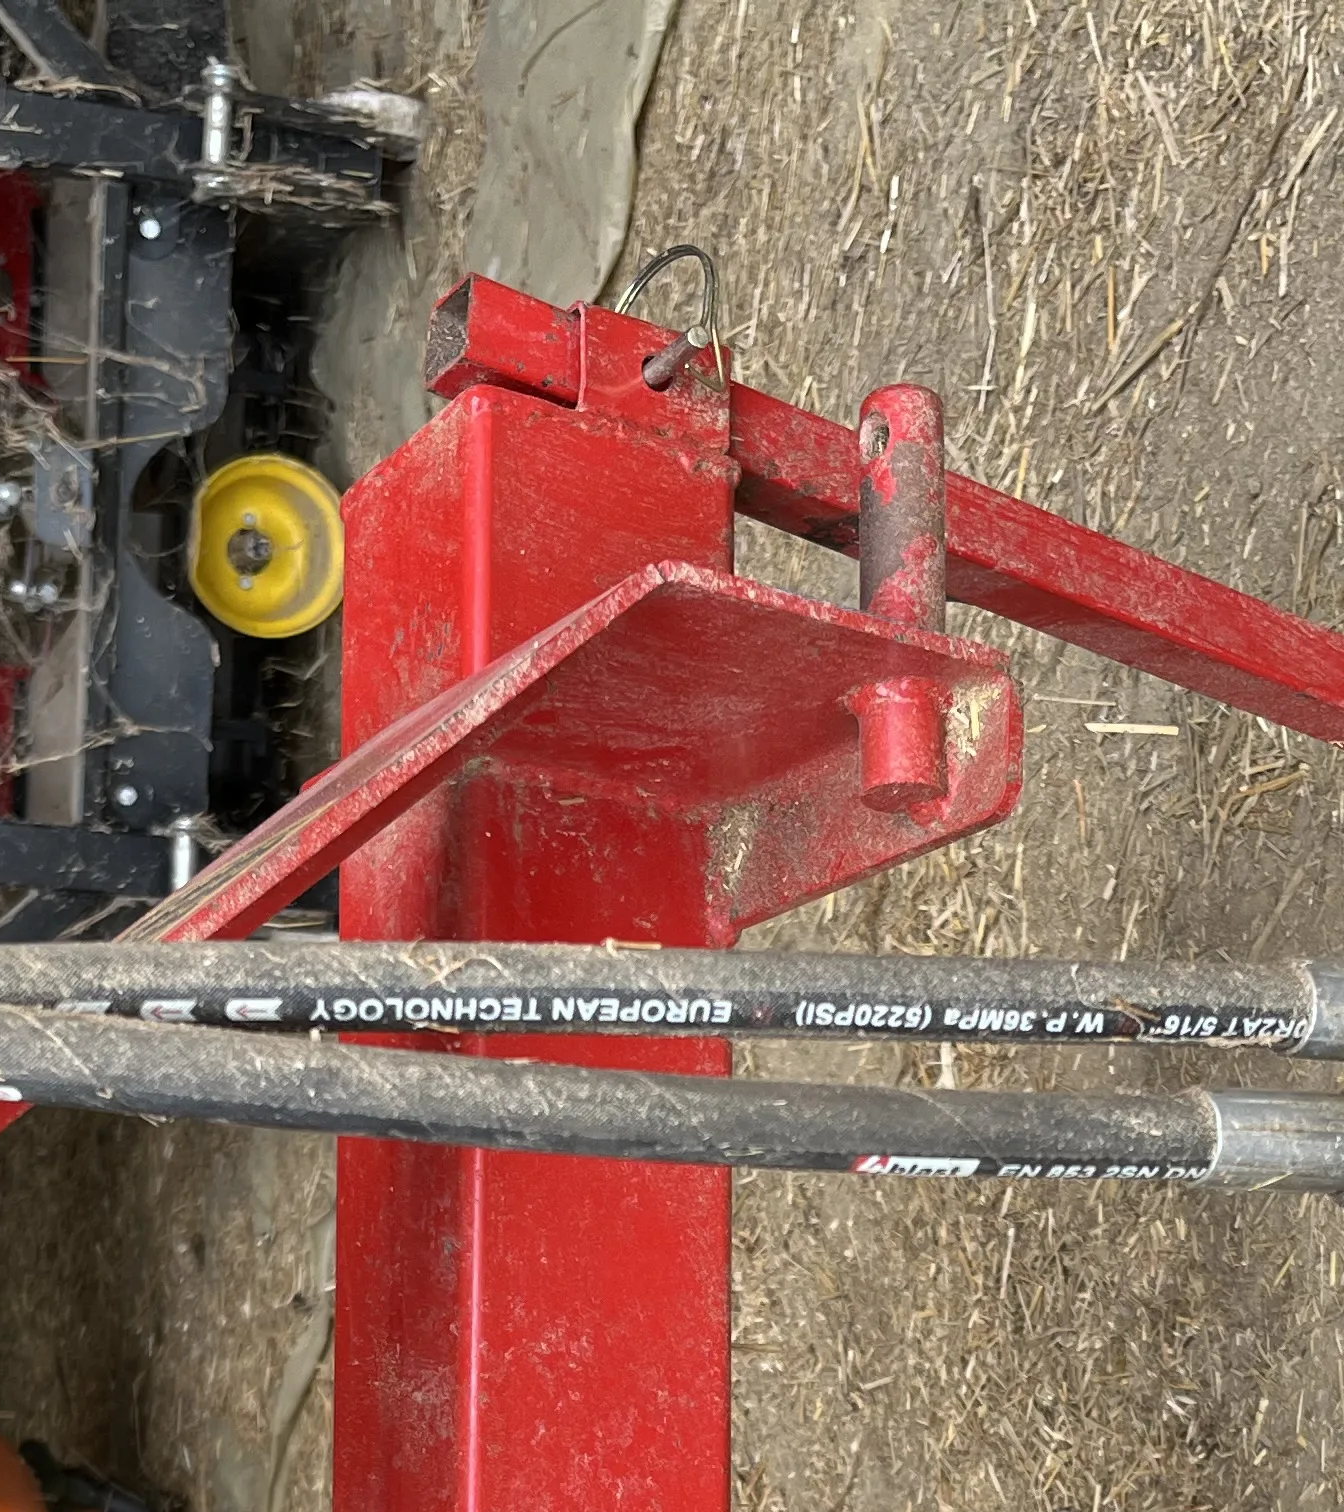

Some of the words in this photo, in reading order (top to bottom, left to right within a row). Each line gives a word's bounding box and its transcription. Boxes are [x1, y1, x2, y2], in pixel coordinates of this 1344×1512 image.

[309, 998, 542, 1022] TECHNOLOGY
[553, 998, 732, 1023] EUROPEAN
[794, 1001, 933, 1030] (5220PSI)
